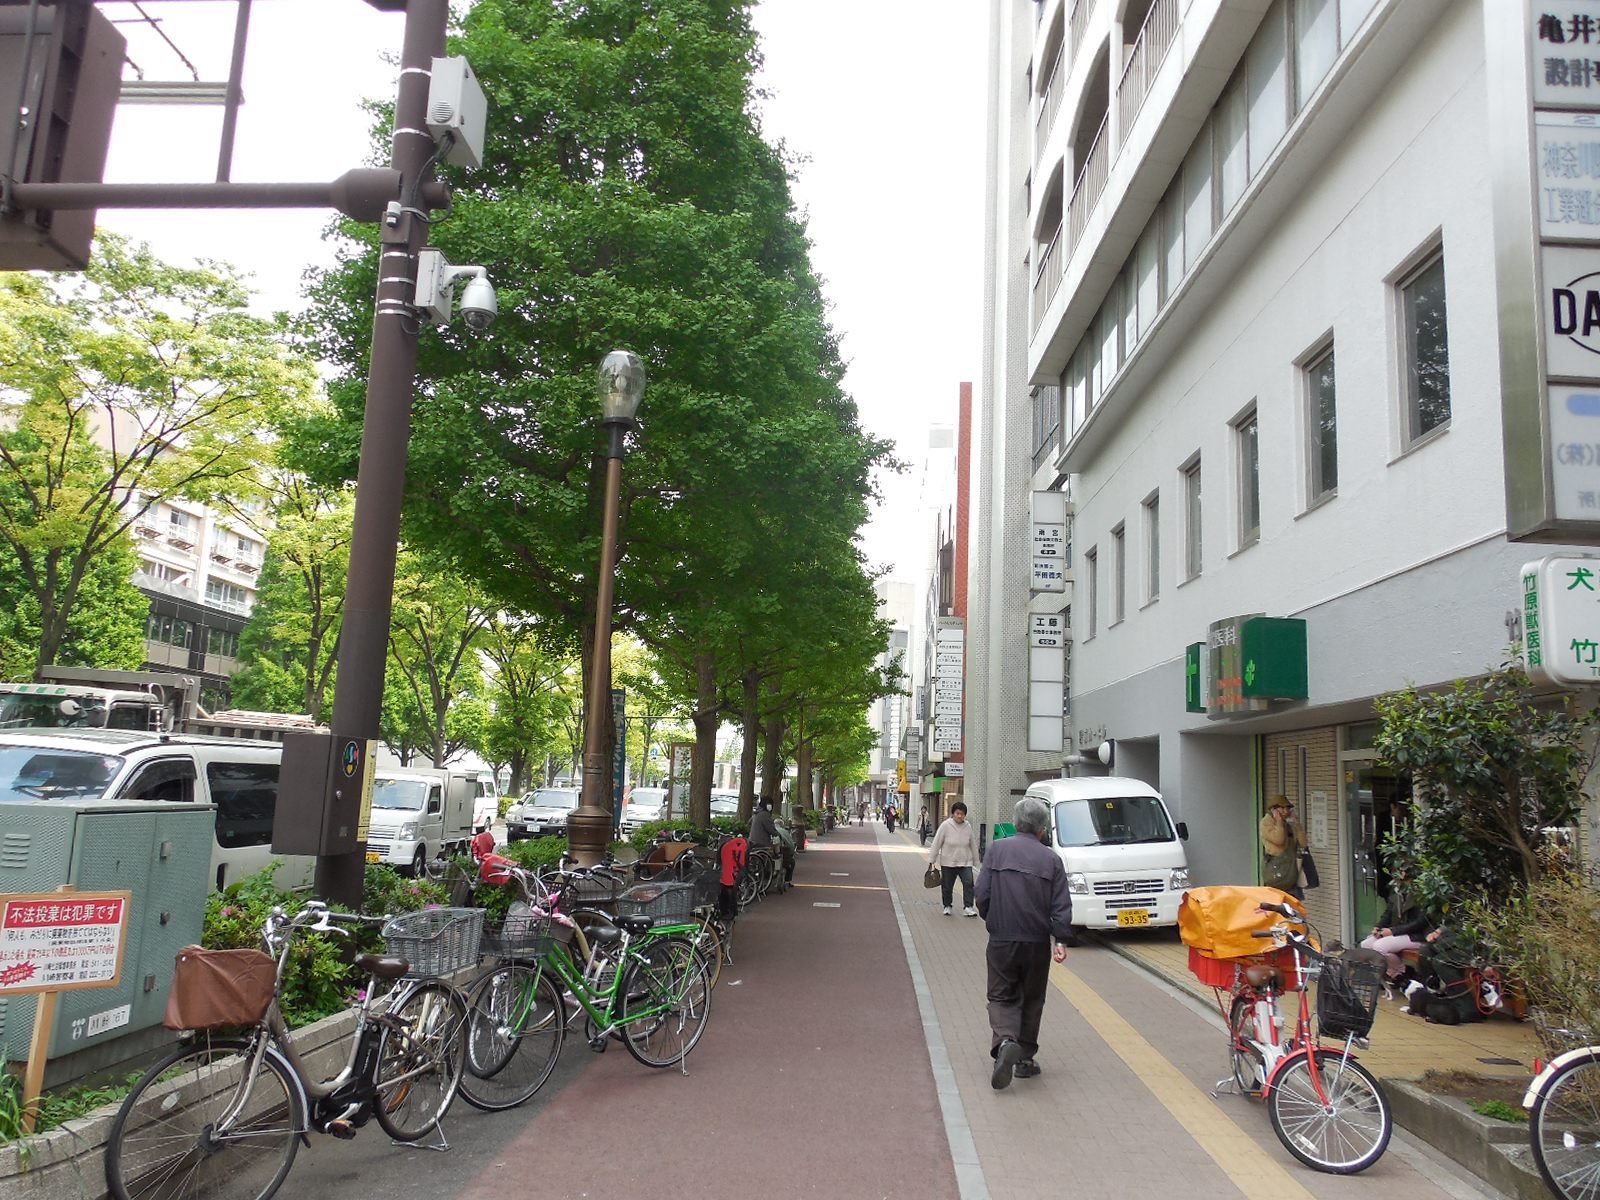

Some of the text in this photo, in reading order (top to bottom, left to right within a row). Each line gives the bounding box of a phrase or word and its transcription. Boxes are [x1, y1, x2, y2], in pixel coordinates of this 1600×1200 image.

[1536, 13, 1600, 44] 亀井
[1557, 443, 1600, 466] (株)
[10, 904, 118, 923] 不法投棄は犯罪です
